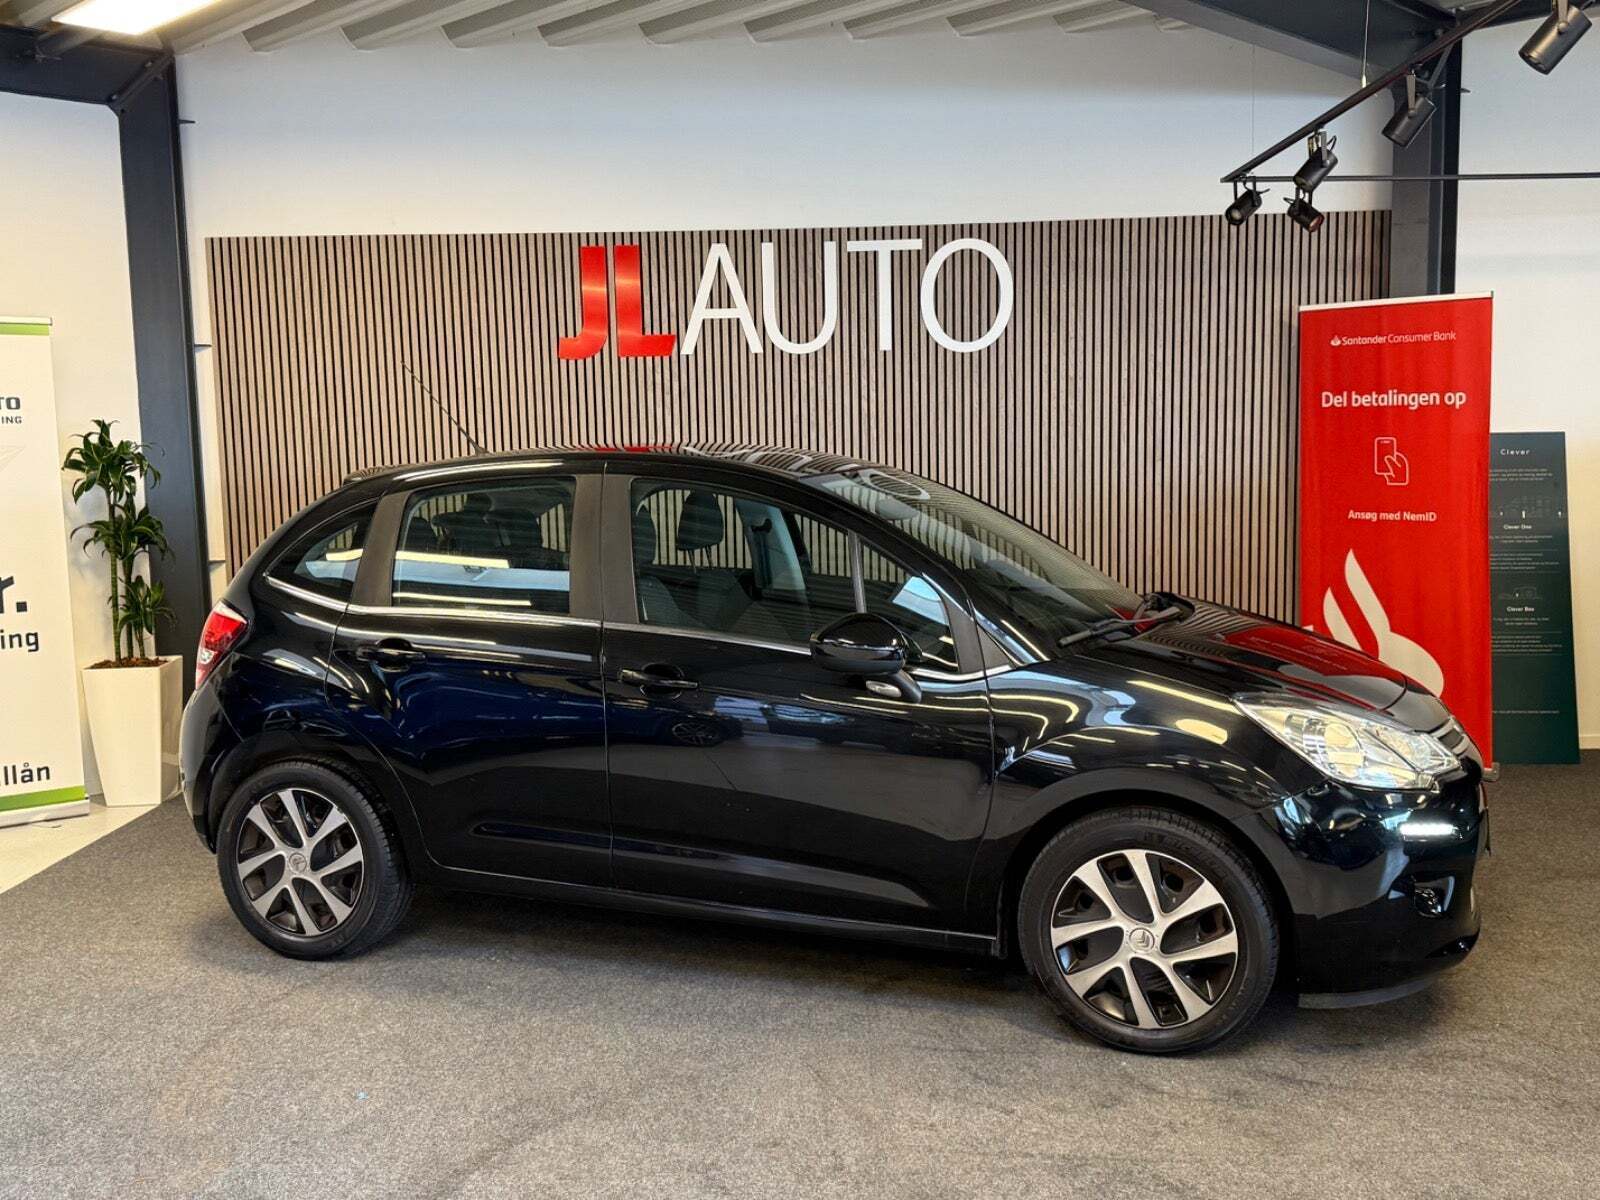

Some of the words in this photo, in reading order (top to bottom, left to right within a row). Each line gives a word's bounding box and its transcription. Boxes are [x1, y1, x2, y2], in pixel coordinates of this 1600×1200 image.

[1341, 335, 1387, 346] Santander
[1387, 333, 1432, 344] Consumer
[1433, 331, 1457, 341] Bank
[1321, 391, 1347, 408] Del
[1351, 389, 1440, 410] betalingen
[1444, 391, 1466, 409] op
[1500, 448, 1530, 456] Clever
[1348, 510, 1377, 522] Ansøg
[1379, 511, 1400, 521] med
[1403, 511, 1437, 522] NemID
